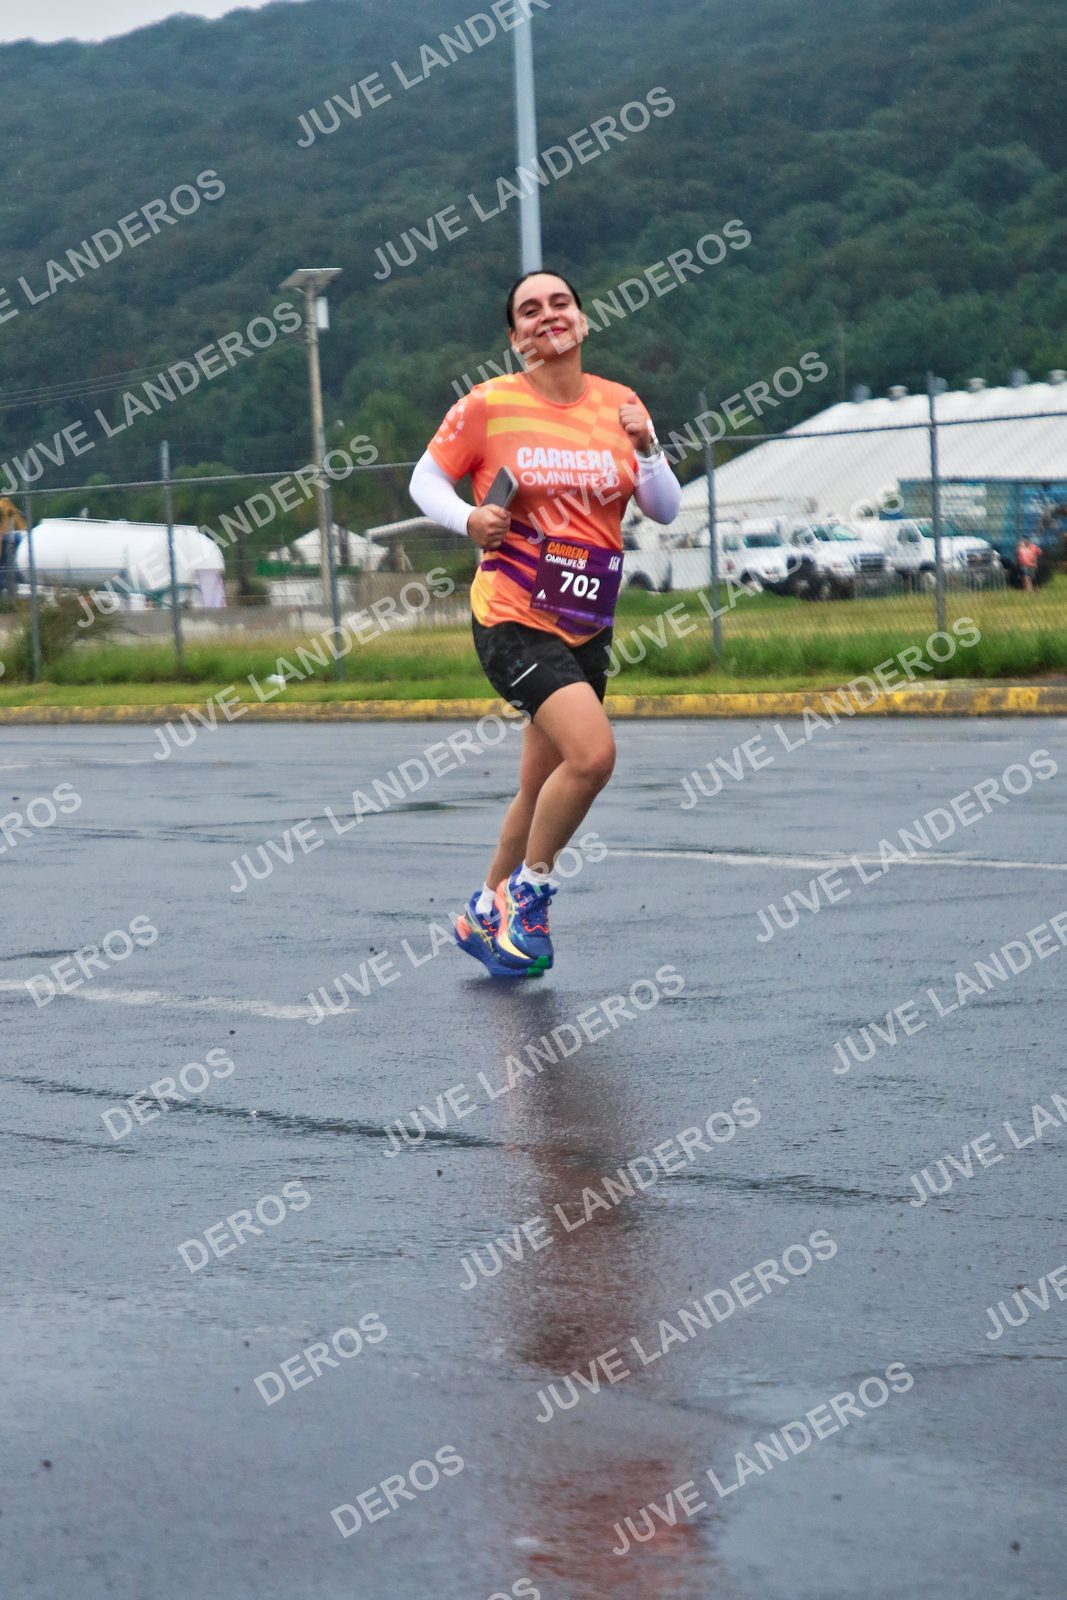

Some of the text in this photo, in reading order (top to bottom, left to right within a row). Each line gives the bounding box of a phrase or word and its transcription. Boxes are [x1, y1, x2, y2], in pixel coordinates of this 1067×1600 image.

[517, 446, 616, 470] CARRERA
[520, 471, 600, 487] OMNILIFE
[547, 541, 590, 560] CARRERA
[545, 553, 577, 568] OMNILIFE
[560, 570, 600, 600] 702
